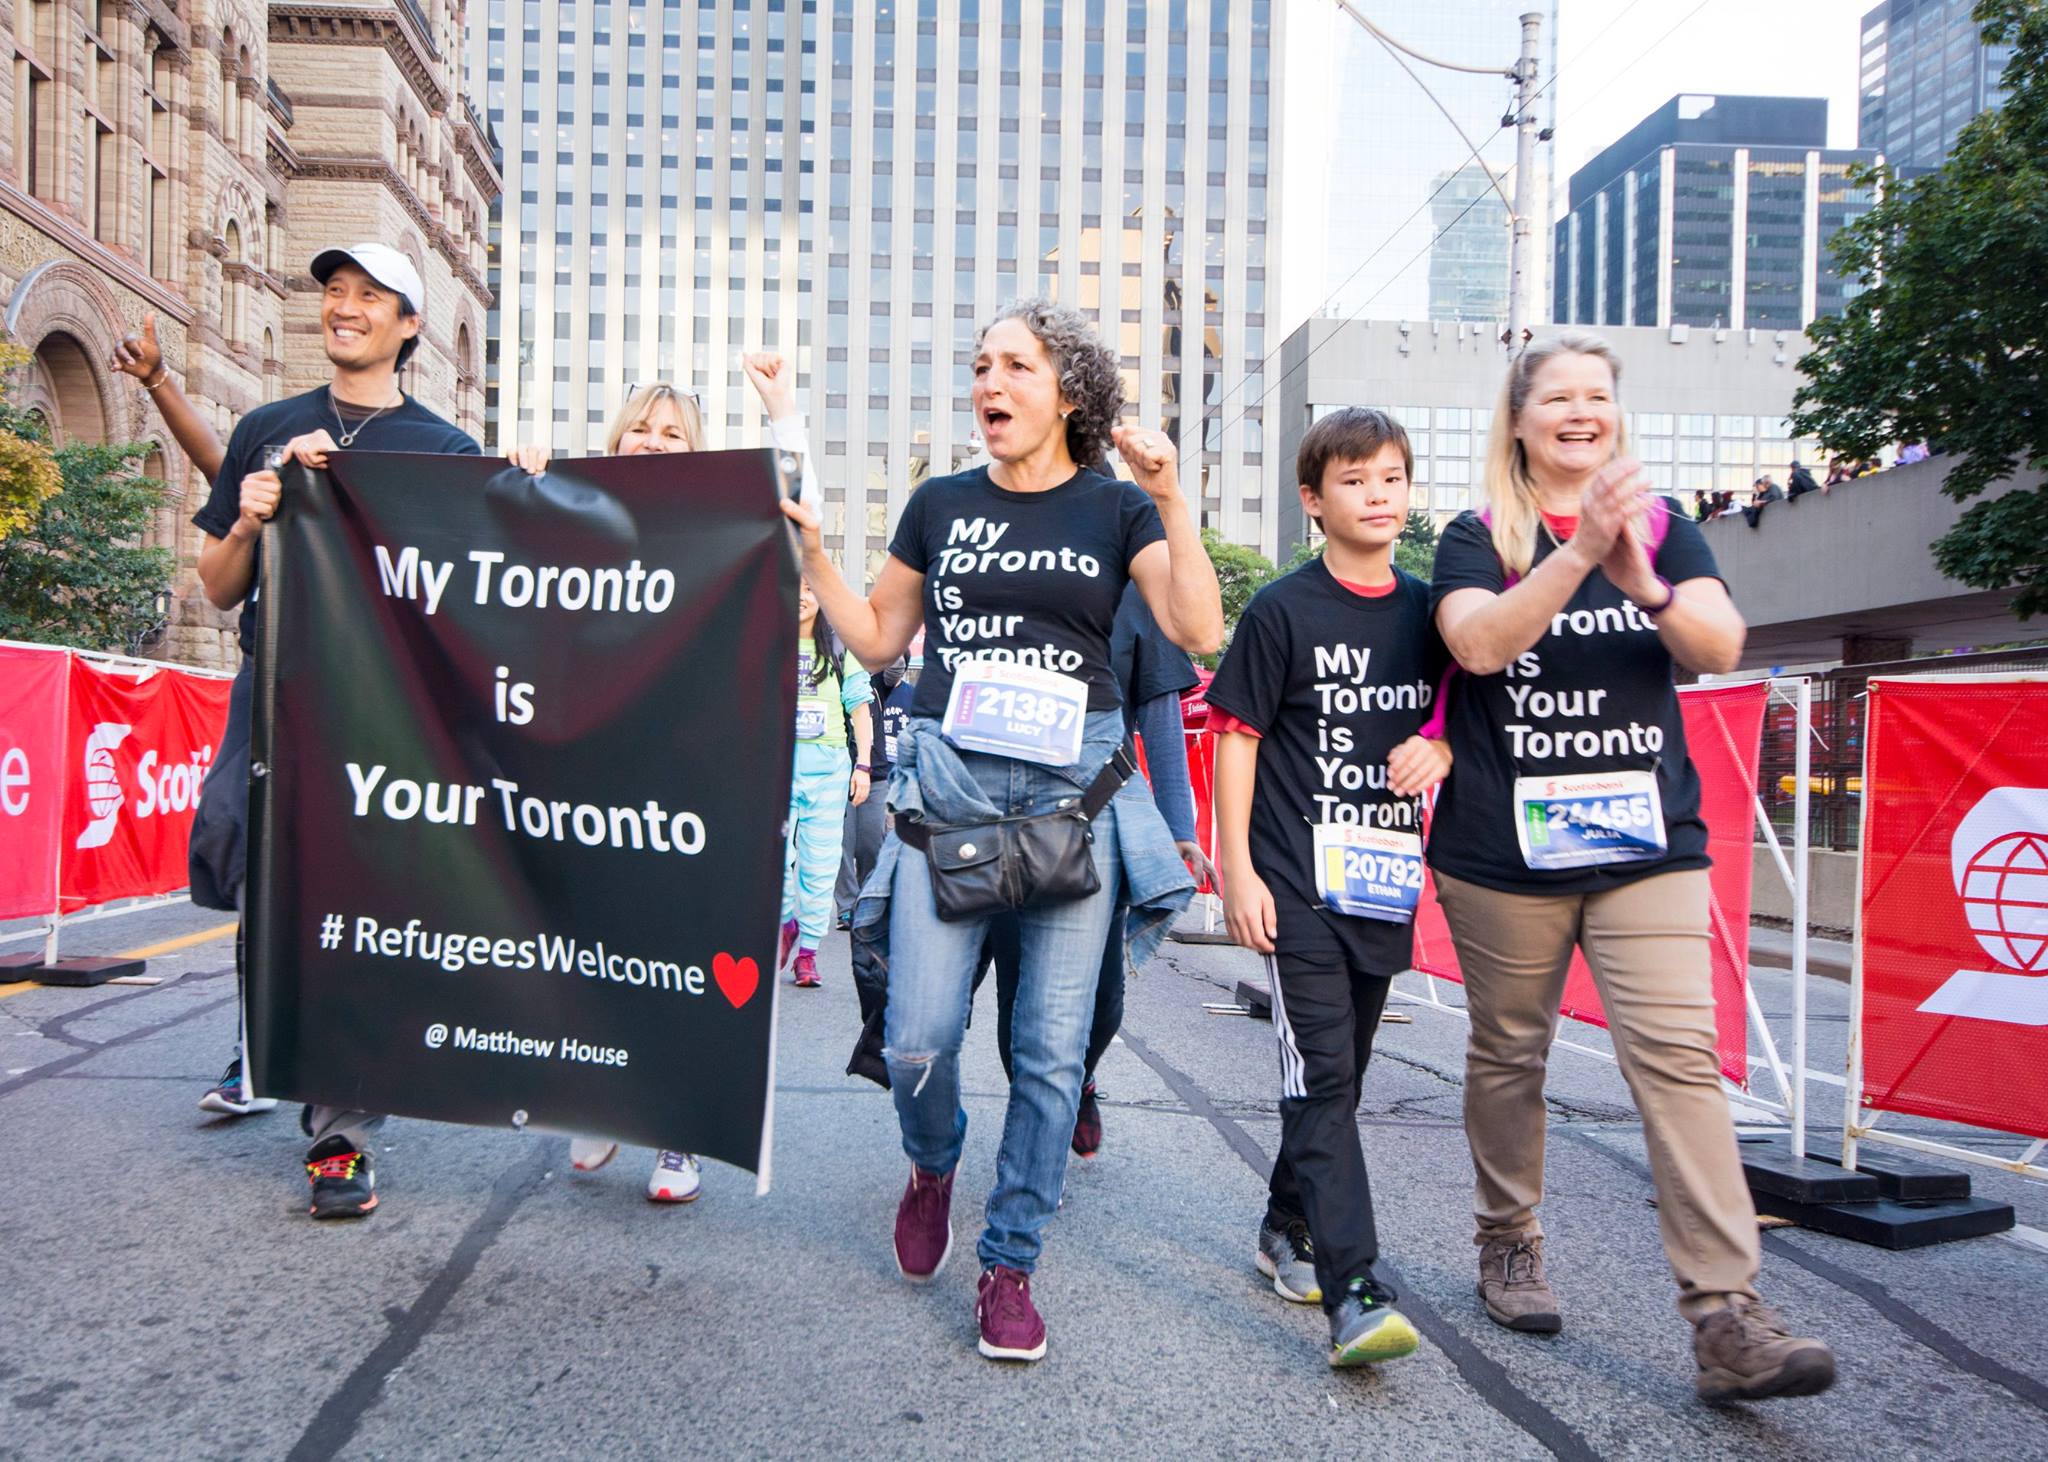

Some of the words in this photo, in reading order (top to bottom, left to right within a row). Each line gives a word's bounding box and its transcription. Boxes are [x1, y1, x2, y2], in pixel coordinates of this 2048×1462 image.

[946, 517, 1010, 552] My
[374, 545, 455, 616] My
[468, 550, 676, 614] Toronto
[938, 547, 1100, 578] Toronto
[933, 580, 964, 612] is
[939, 614, 1024, 643] Your
[1552, 600, 1659, 636] ront
[937, 643, 1084, 673] Toronto
[1313, 642, 1372, 685] My
[495, 665, 535, 726] is
[976, 686, 1079, 731] 21387
[1505, 684, 1607, 718] Your
[1005, 721, 1043, 737] LUCY
[1317, 718, 1355, 753] is
[1504, 721, 1664, 759] Toronto
[136, 744, 212, 818] Scoti
[1314, 756, 1386, 791] You
[345, 762, 485, 826] Your
[491, 778, 706, 855] Toronto
[1313, 793, 1422, 828] Toront
[1344, 850, 1421, 889] 20792
[319, 913, 345, 950] #
[354, 916, 705, 995] RefugeesWelcome
[425, 1023, 448, 1048] @
[454, 1026, 555, 1058] Matthew
[560, 1037, 629, 1067] House
